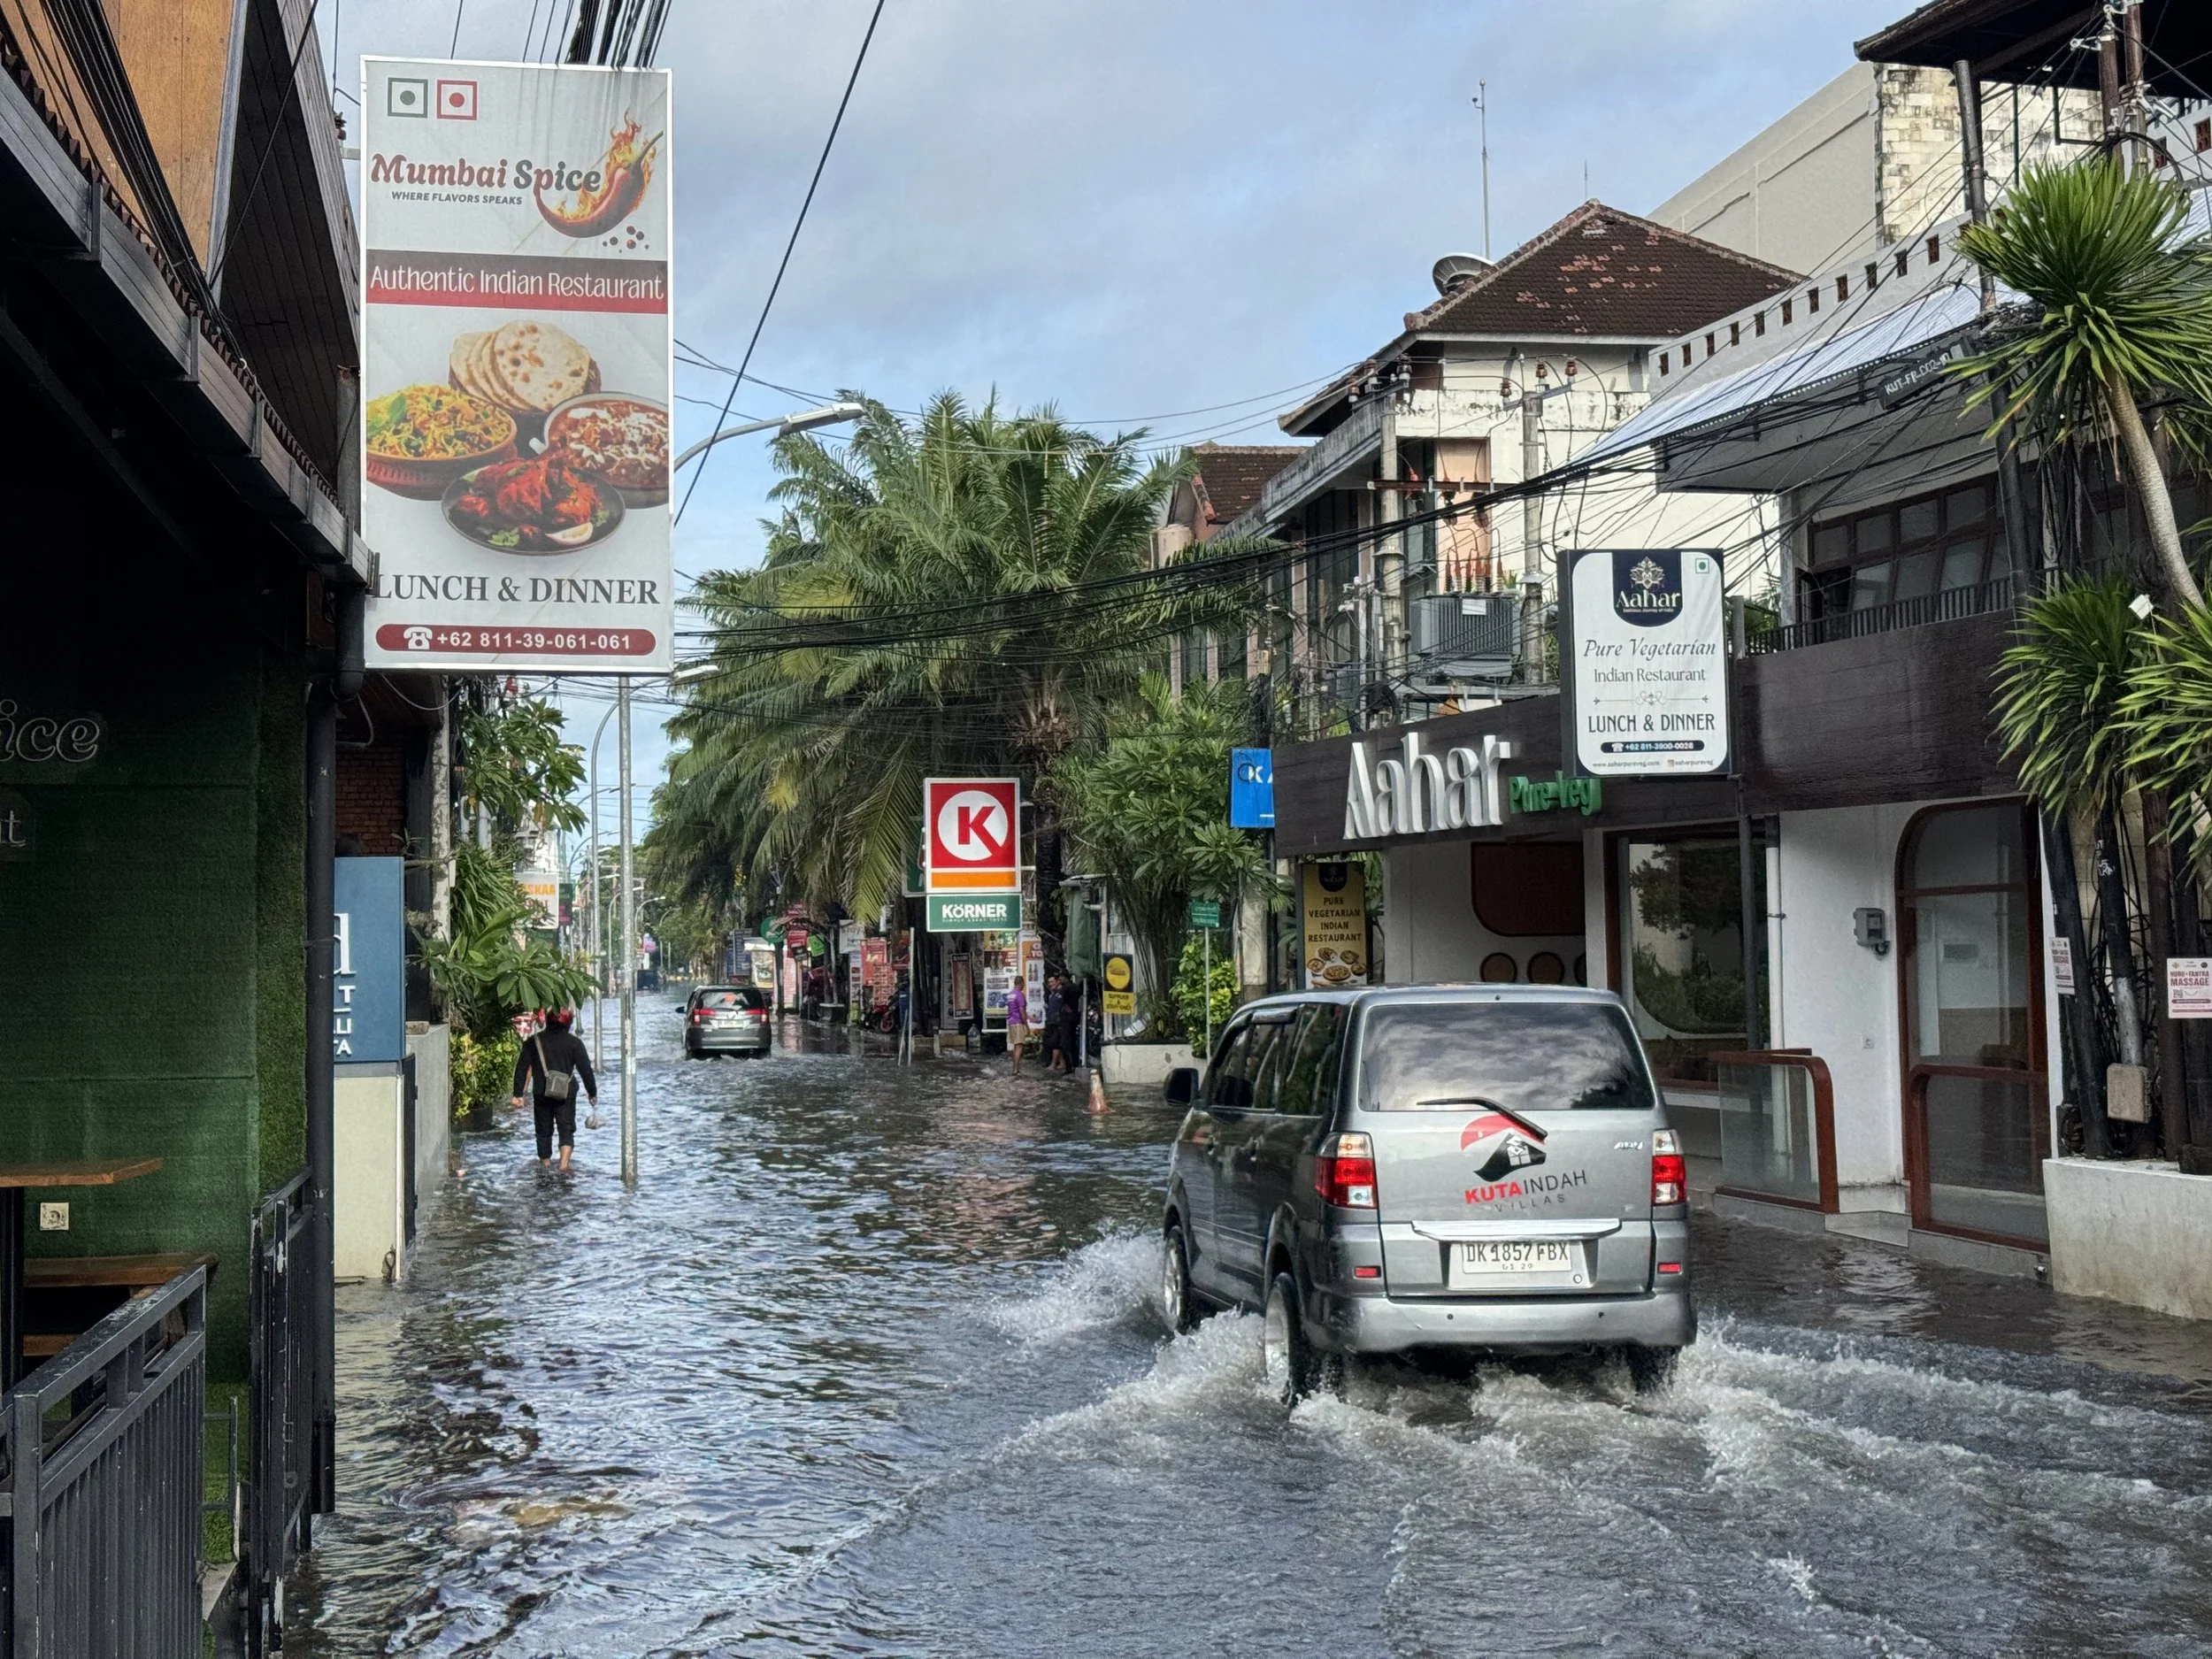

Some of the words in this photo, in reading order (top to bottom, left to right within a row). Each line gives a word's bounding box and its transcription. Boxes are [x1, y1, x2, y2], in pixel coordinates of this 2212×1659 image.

[371, 153, 507, 188] Mumbai
[513, 159, 602, 197] Spice
[392, 191, 430, 201] WHERE
[432, 193, 480, 204] FLAVORS
[482, 195, 523, 204] SPEAKS
[370, 265, 474, 292] Authentic
[480, 269, 543, 296] Indian
[549, 272, 664, 300] Restaurant
[374, 573, 489, 602] LUNCH
[498, 577, 521, 603] &
[528, 578, 661, 604] DINNER
[1616, 589, 1681, 608] Aahar
[437, 632, 472, 647] +62
[480, 633, 630, 650] 811-39-061-061
[1583, 639, 1623, 657] Pure
[1594, 667, 1634, 682] Indian
[1636, 667, 1707, 682] Restaurant
[1587, 715, 1637, 733] LUNCH
[1643, 714, 1655, 732] &
[1660, 713, 1716, 731] DINNER
[1248, 765, 1274, 784] K
[1342, 732, 1510, 841] Aahar
[1509, 775, 1555, 814] Pure
[957, 806, 1002, 856] K
[1323, 896, 1344, 905] PURE
[942, 903, 1008, 918] KÖRNER
[1308, 908, 1361, 918] VEGETARIAN
[1320, 921, 1349, 931] INDIAN
[1308, 933, 1362, 942] RESTAURANT
[2170, 978, 2209, 987] MASSAGE
[1494, 1194, 1566, 1213] VILLAS
[1466, 1242, 1487, 1263] DK
[1490, 1241, 1532, 1262] 1857
[1537, 1241, 1569, 1261] FBX
